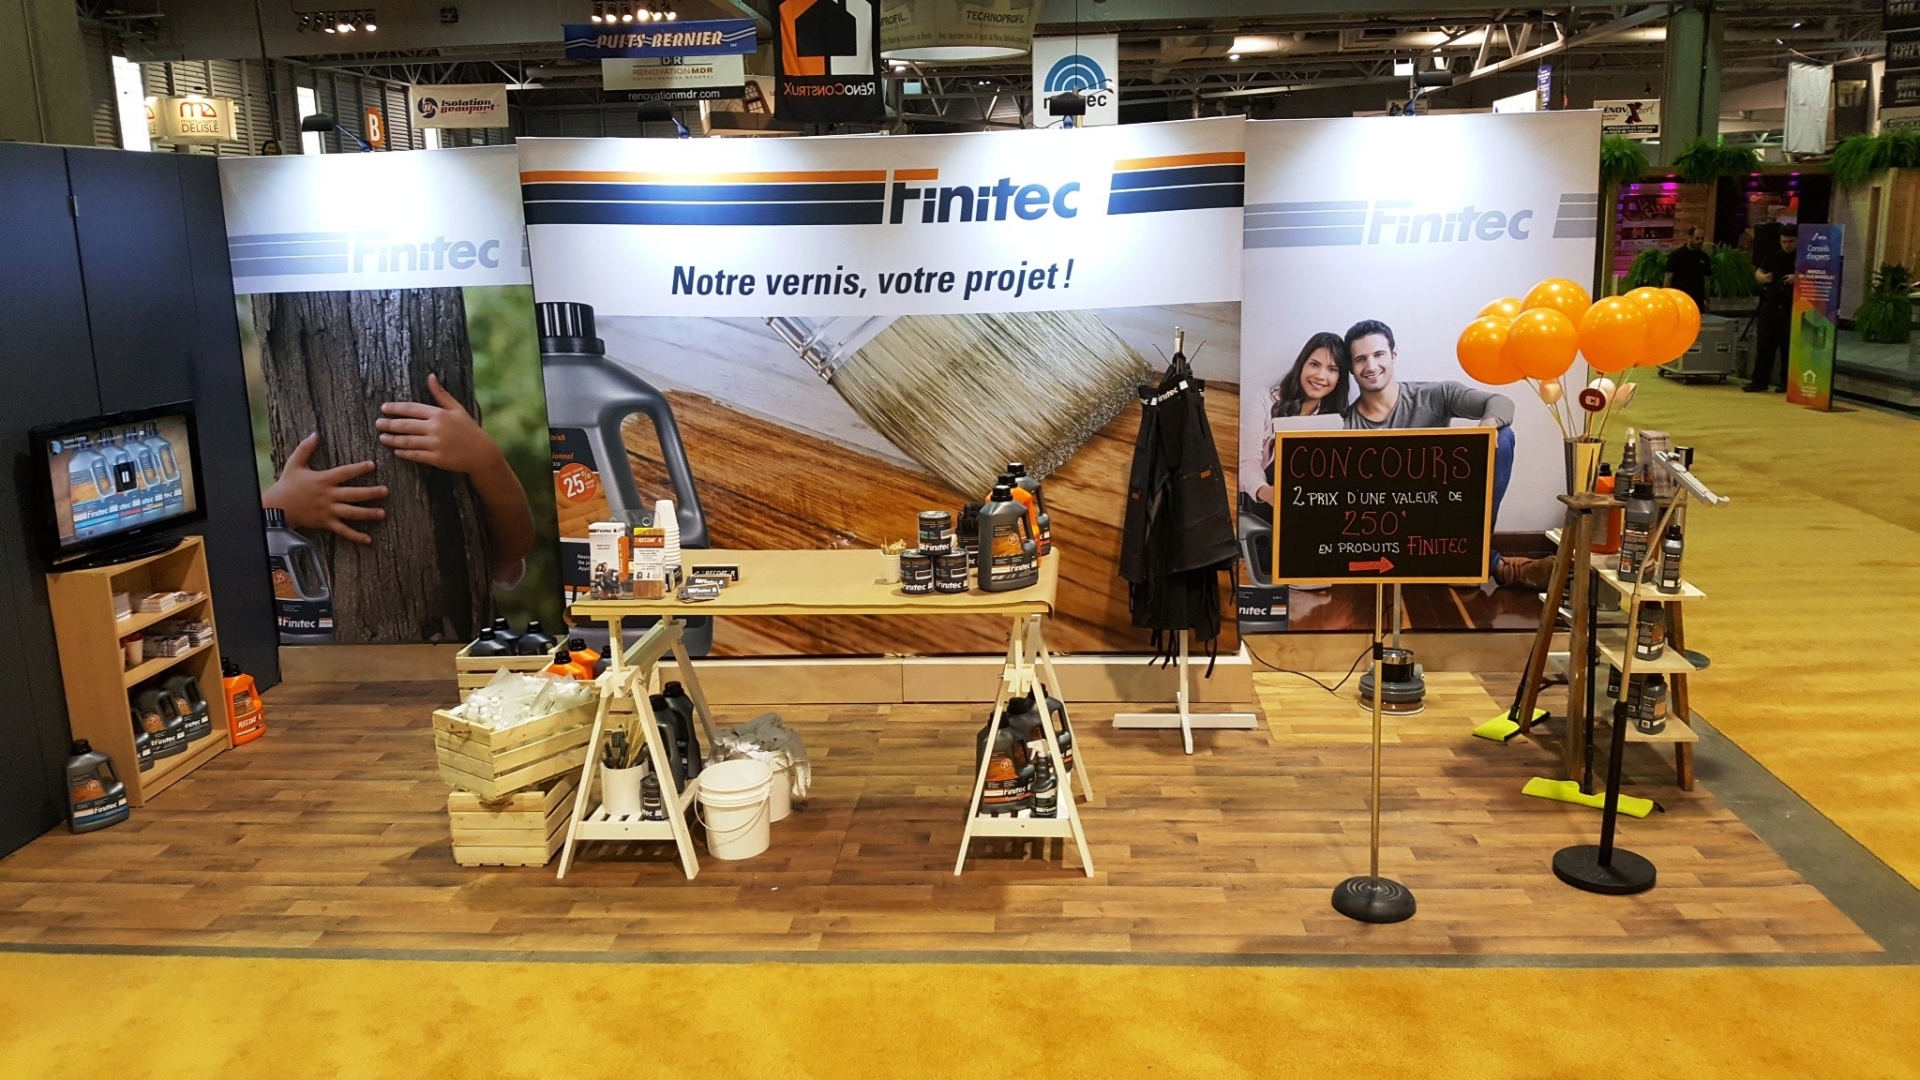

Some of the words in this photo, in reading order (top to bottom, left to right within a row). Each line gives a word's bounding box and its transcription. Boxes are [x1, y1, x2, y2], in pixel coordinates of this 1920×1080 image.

[880, 12, 905, 27] PROFIL
[966, 11, 1025, 23] TECHNOPROFIL
[597, 33, 646, 49] PUITS
[651, 30, 724, 47] BERNIER
[441, 98, 491, 107] Isolation
[628, 89, 720, 101] renovationmdr.com
[440, 104, 496, 115] Beauport
[181, 124, 220, 133] DELISLE
[368, 113, 381, 142] B
[889, 168, 1081, 225] Finitec
[1367, 201, 1535, 246] Finitec
[353, 231, 501, 274] Finitec
[671, 265, 756, 296] Notre
[766, 264, 868, 299] vernis,
[878, 267, 956, 295] votre
[1290, 446, 1471, 484] CONCOURS
[1292, 486, 1305, 506] 2
[1307, 491, 1340, 506] PRIX
[1347, 489, 1386, 505] D'UNE
[1392, 490, 1439, 504] VALEUR
[1449, 491, 1463, 502] DE
[1318, 544, 1333, 555] EN
[1338, 541, 1400, 554] PRODUITS
[1407, 535, 1468, 556] FINITEC
[1239, 606, 1268, 616] nitec
[282, 617, 316, 628] Finitec
